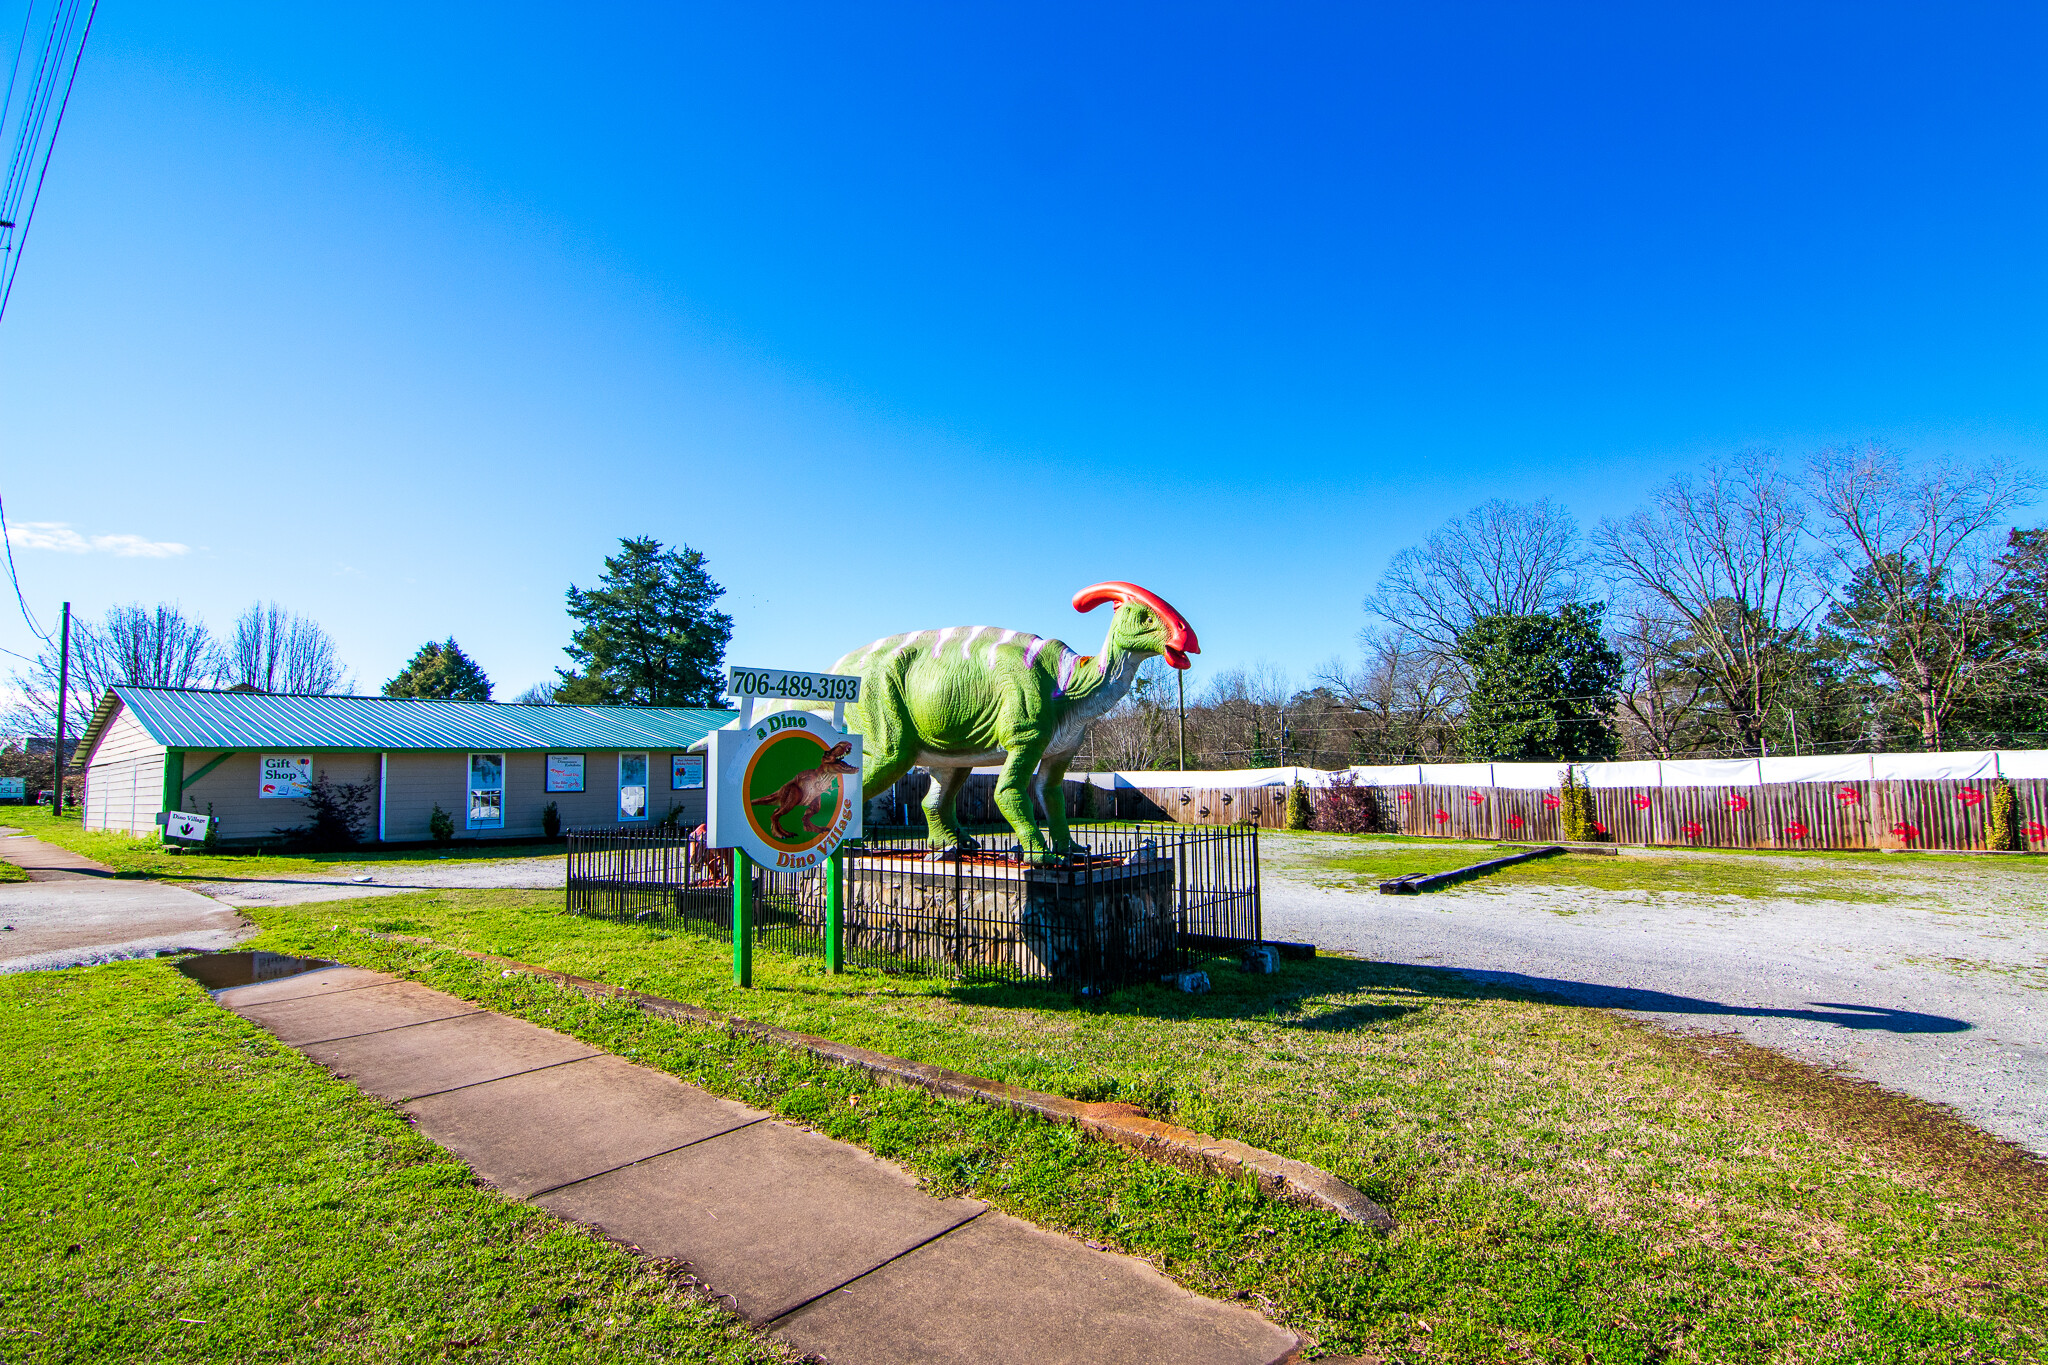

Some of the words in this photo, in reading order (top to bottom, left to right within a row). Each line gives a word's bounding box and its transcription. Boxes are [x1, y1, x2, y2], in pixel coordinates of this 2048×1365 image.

[733, 671, 857, 700] 706-489-3193
[756, 727, 768, 741] a
[767, 714, 808, 733] Dino
[265, 758, 290, 768] Gift
[265, 769, 297, 781] Shop
[0, 786, 23, 794] ISLE
[172, 813, 187, 821] Dino
[187, 815, 206, 824] Village
[776, 851, 817, 868] Dino
[817, 798, 853, 855] Village
